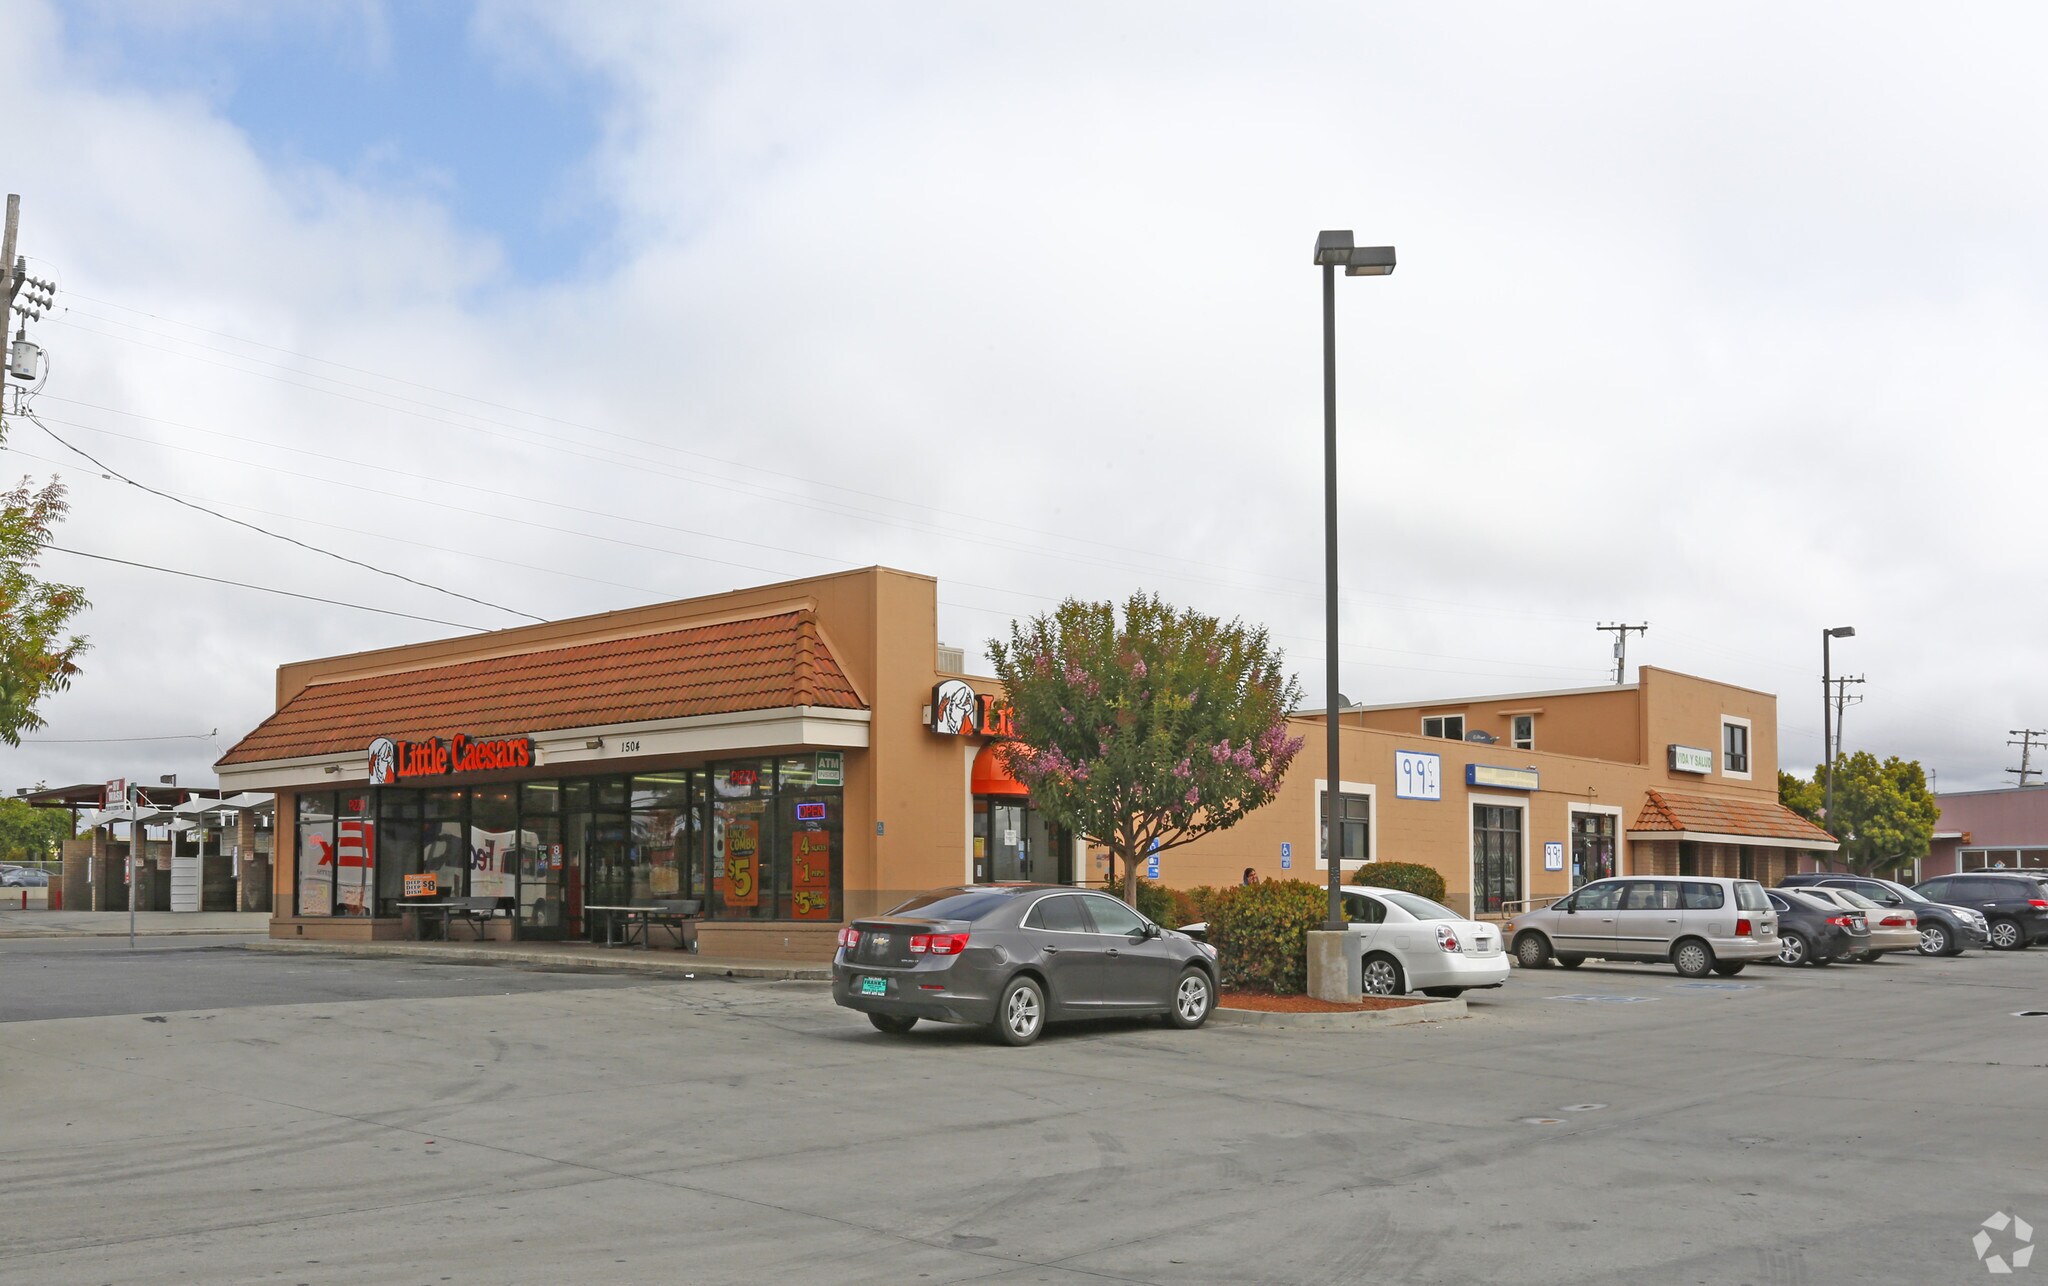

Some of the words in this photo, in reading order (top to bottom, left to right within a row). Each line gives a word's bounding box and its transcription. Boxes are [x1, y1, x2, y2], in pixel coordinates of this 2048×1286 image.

[621, 741, 640, 752] 1504
[397, 737, 448, 777] Little
[451, 733, 530, 772] Caesars
[1677, 752, 1689, 765] VIDA
[1690, 754, 1694, 766] Y
[1695, 755, 1712, 768] SALUD
[819, 758, 839, 769] ATM
[731, 769, 758, 785] PIZZA
[820, 771, 839, 779] INSIDE
[800, 805, 825, 818] OPEN
[729, 838, 757, 851] COMBO
[800, 835, 810, 855] 4
[728, 857, 753, 897] $5
[803, 863, 810, 882] 1
[422, 880, 435, 892] $8
[795, 891, 811, 915] $5
